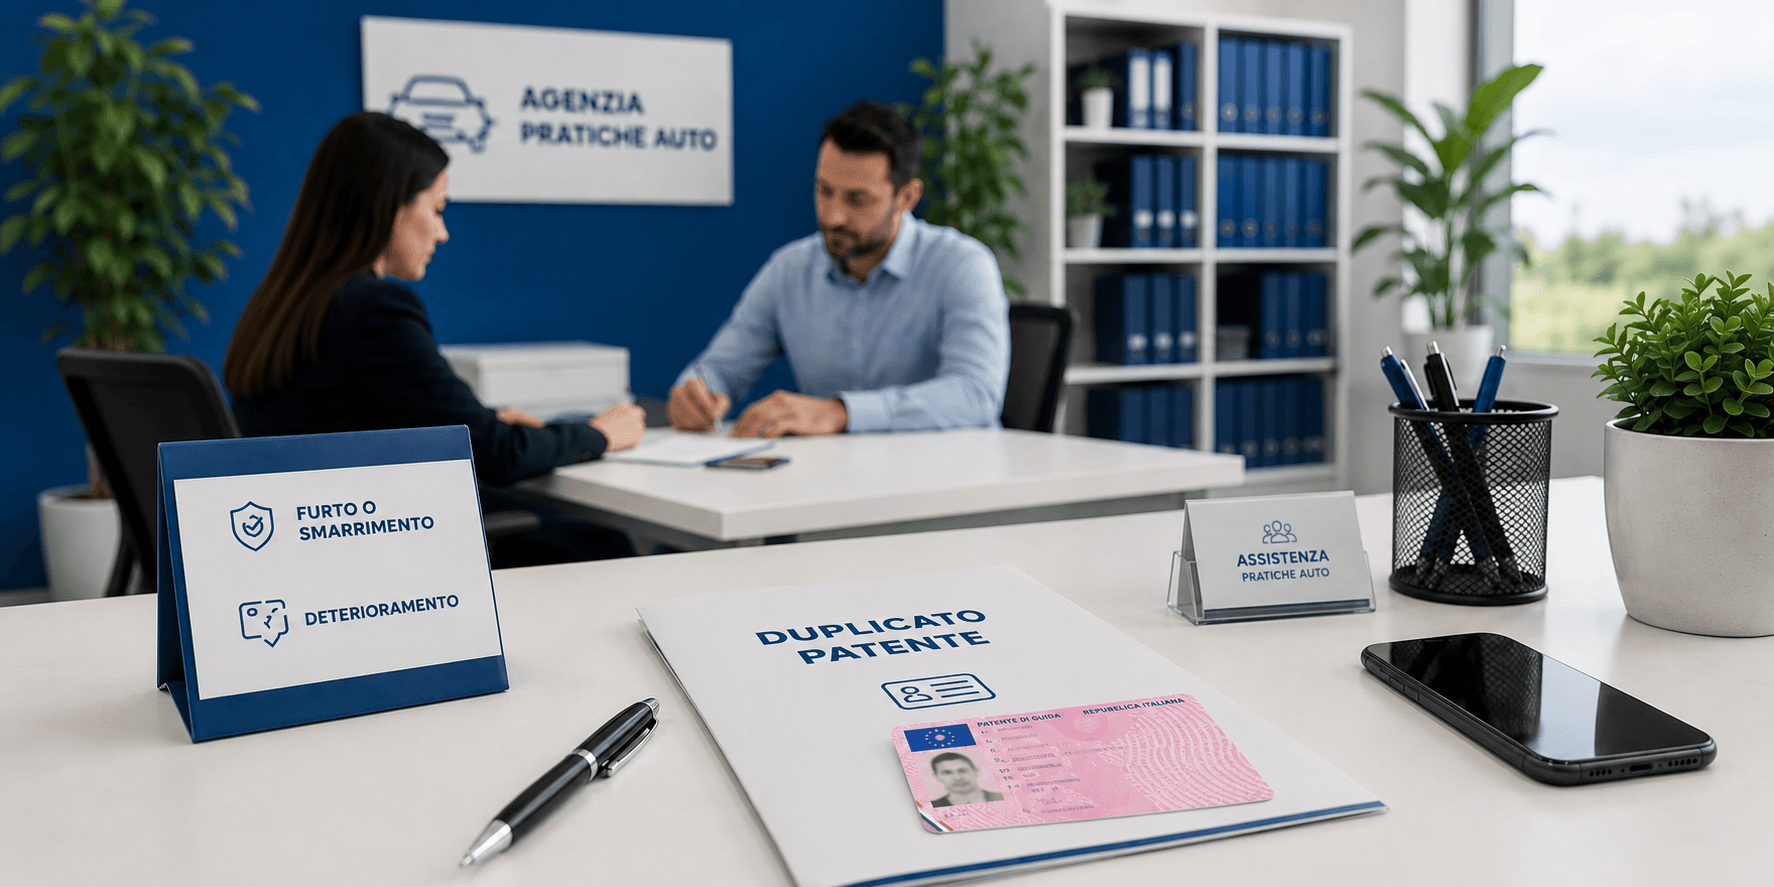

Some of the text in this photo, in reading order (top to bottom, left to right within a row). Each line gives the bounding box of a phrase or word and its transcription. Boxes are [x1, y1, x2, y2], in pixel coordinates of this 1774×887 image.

[519, 86, 645, 115] AGENZIA
[520, 121, 719, 151] PRATICHE AUTO
[296, 500, 377, 520] FURTO O
[299, 516, 435, 541] SMARRIMENTO
[1237, 549, 1330, 567] ASSISTENZA
[1242, 567, 1330, 582] PRATICHE AUTO
[304, 594, 460, 627] DETERIORAMENTO
[755, 610, 987, 645] DUPLICATO
[797, 630, 991, 664] PATENTE
[1142, 698, 1186, 709] ITALIANA
[976, 717, 1018, 727] PATENTE
[1020, 715, 1030, 723] DI
